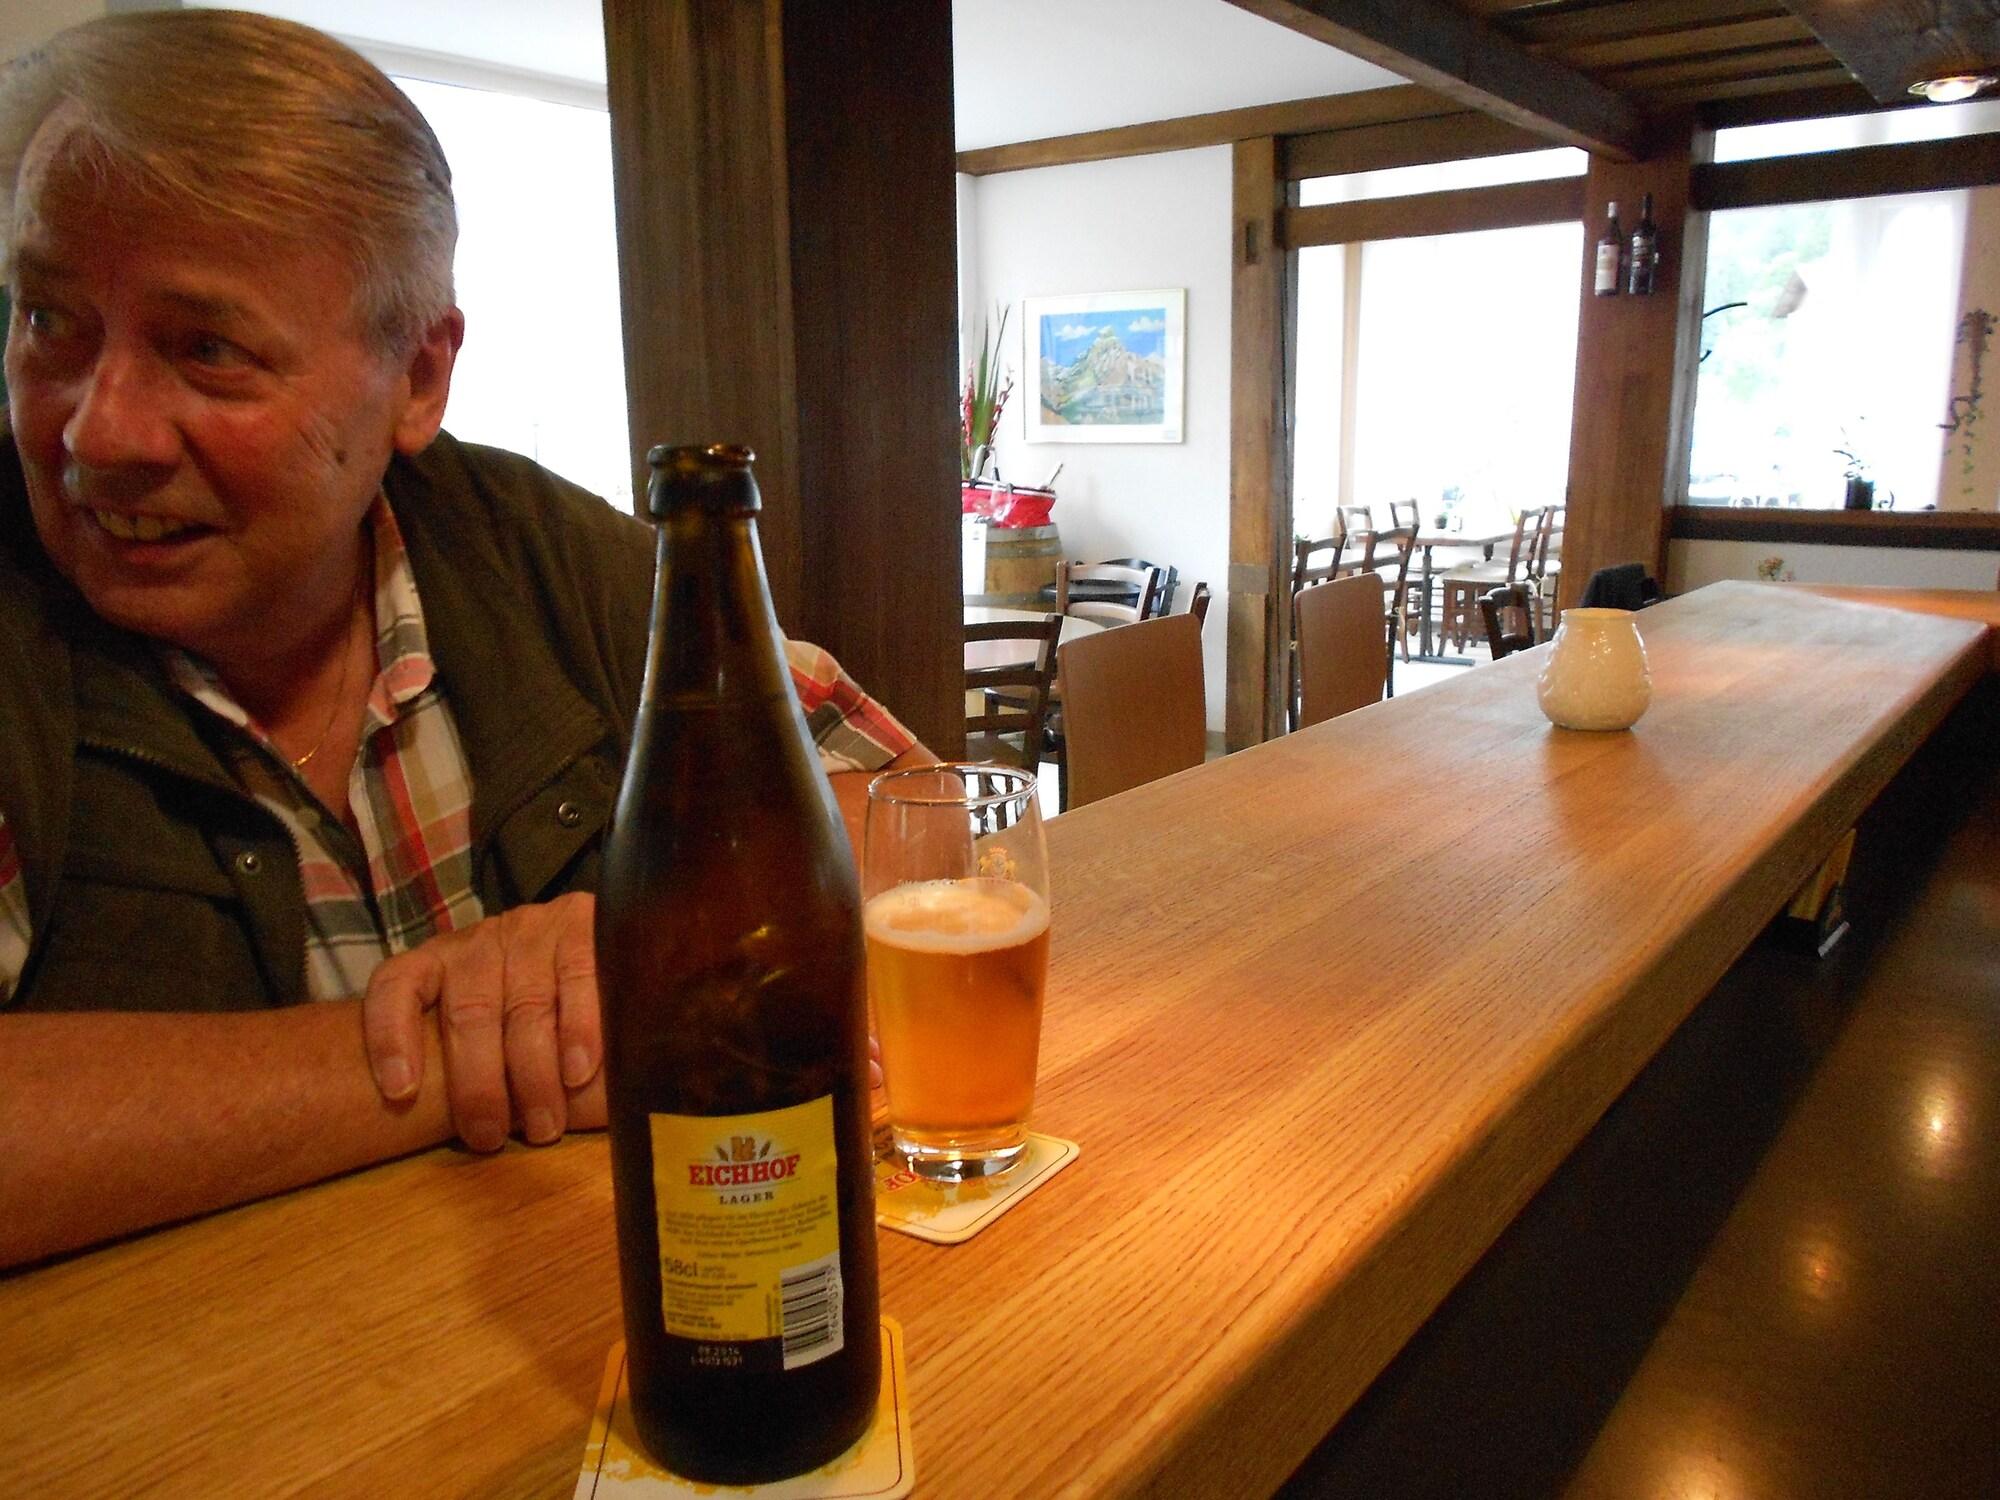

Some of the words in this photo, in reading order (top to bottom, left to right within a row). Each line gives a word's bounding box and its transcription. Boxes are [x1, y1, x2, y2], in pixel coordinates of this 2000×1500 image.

[689, 1154, 800, 1186] EICHHOF
[719, 1191, 774, 1205] LAGER
[664, 1257, 698, 1277] 58cl
